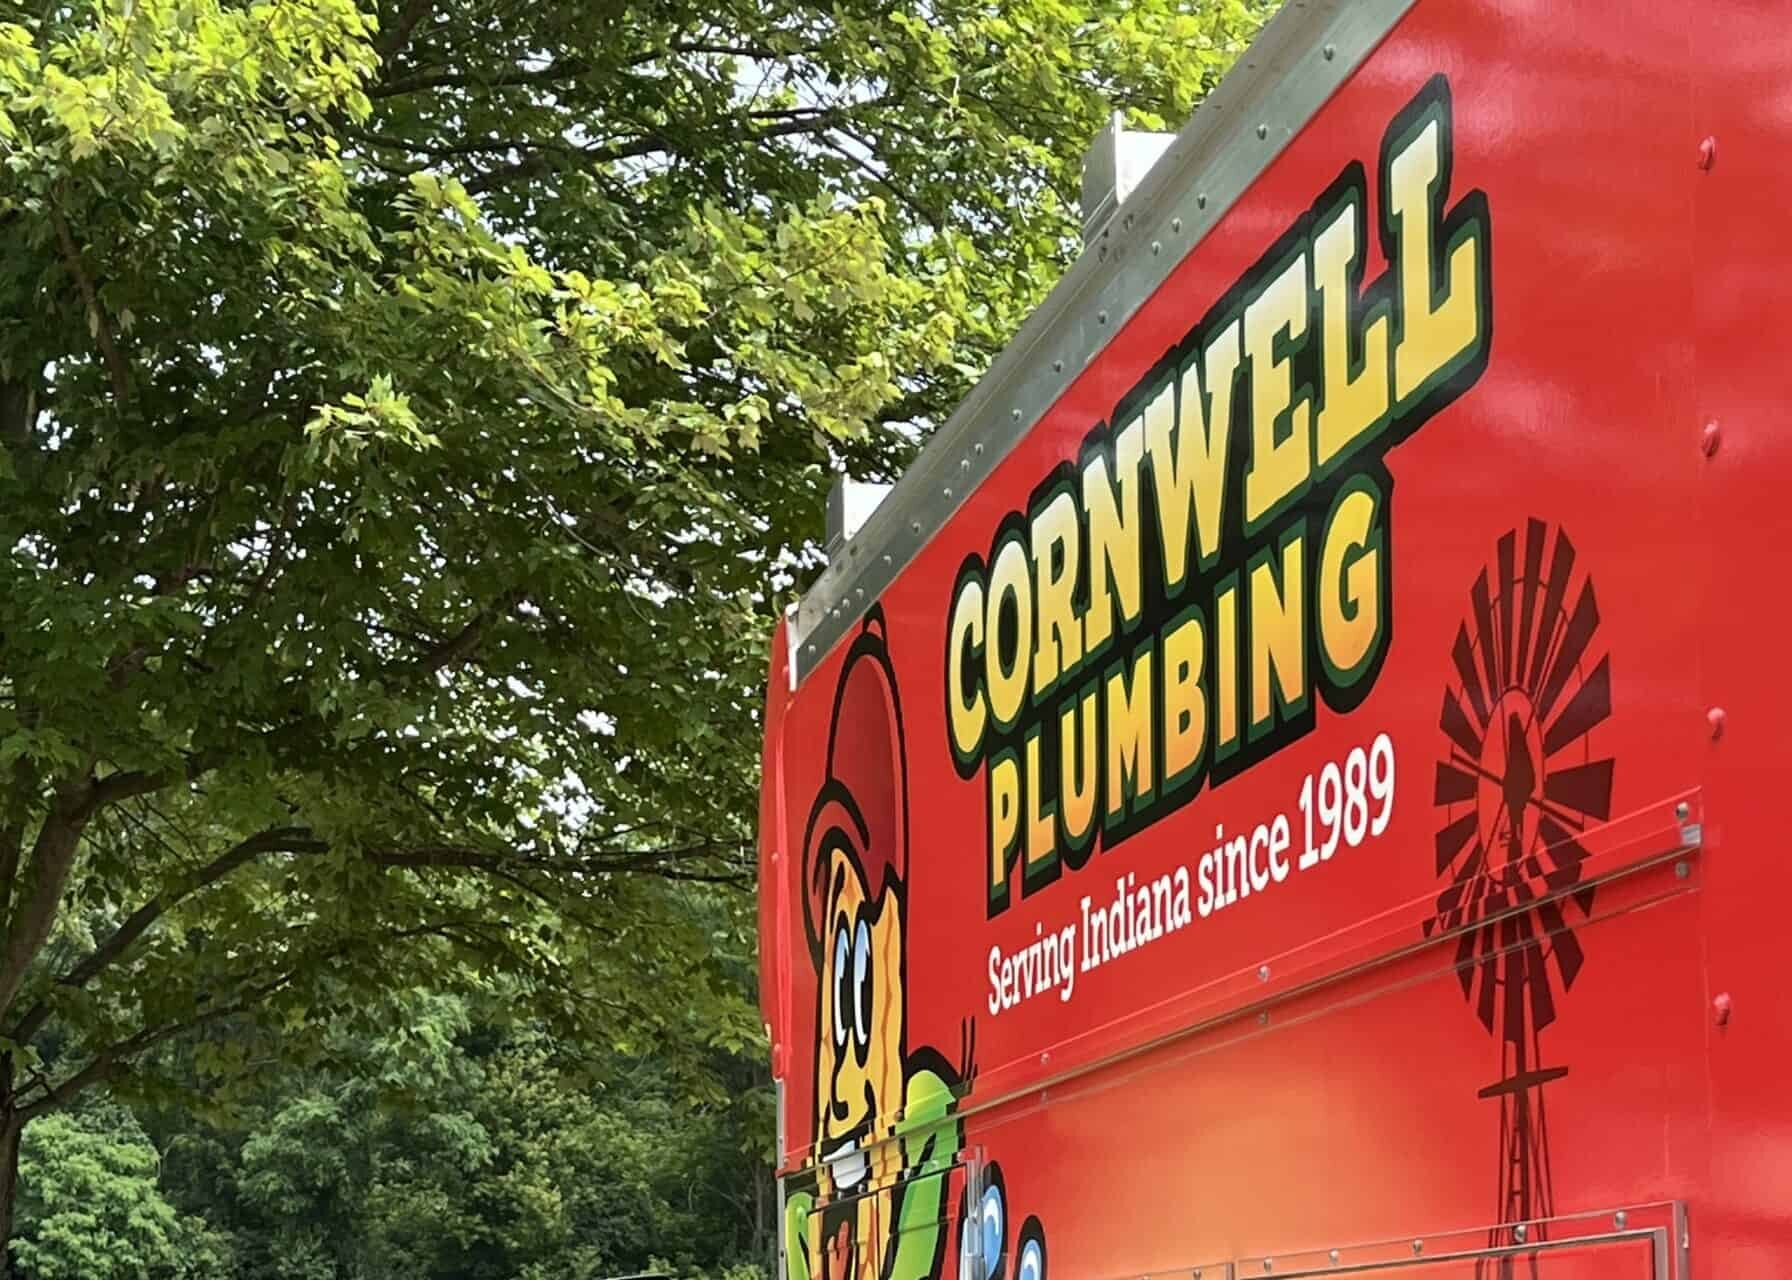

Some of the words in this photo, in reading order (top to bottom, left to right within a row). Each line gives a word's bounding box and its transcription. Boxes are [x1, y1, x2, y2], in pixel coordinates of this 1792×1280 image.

[947, 118, 1478, 754] CORNWELL
[988, 922, 1077, 1015] Serving
[1080, 864, 1191, 973] Indiana
[1197, 813, 1290, 918] since
[1298, 732, 1396, 871] 1989
[991, 491, 1379, 886] PLUMBING
